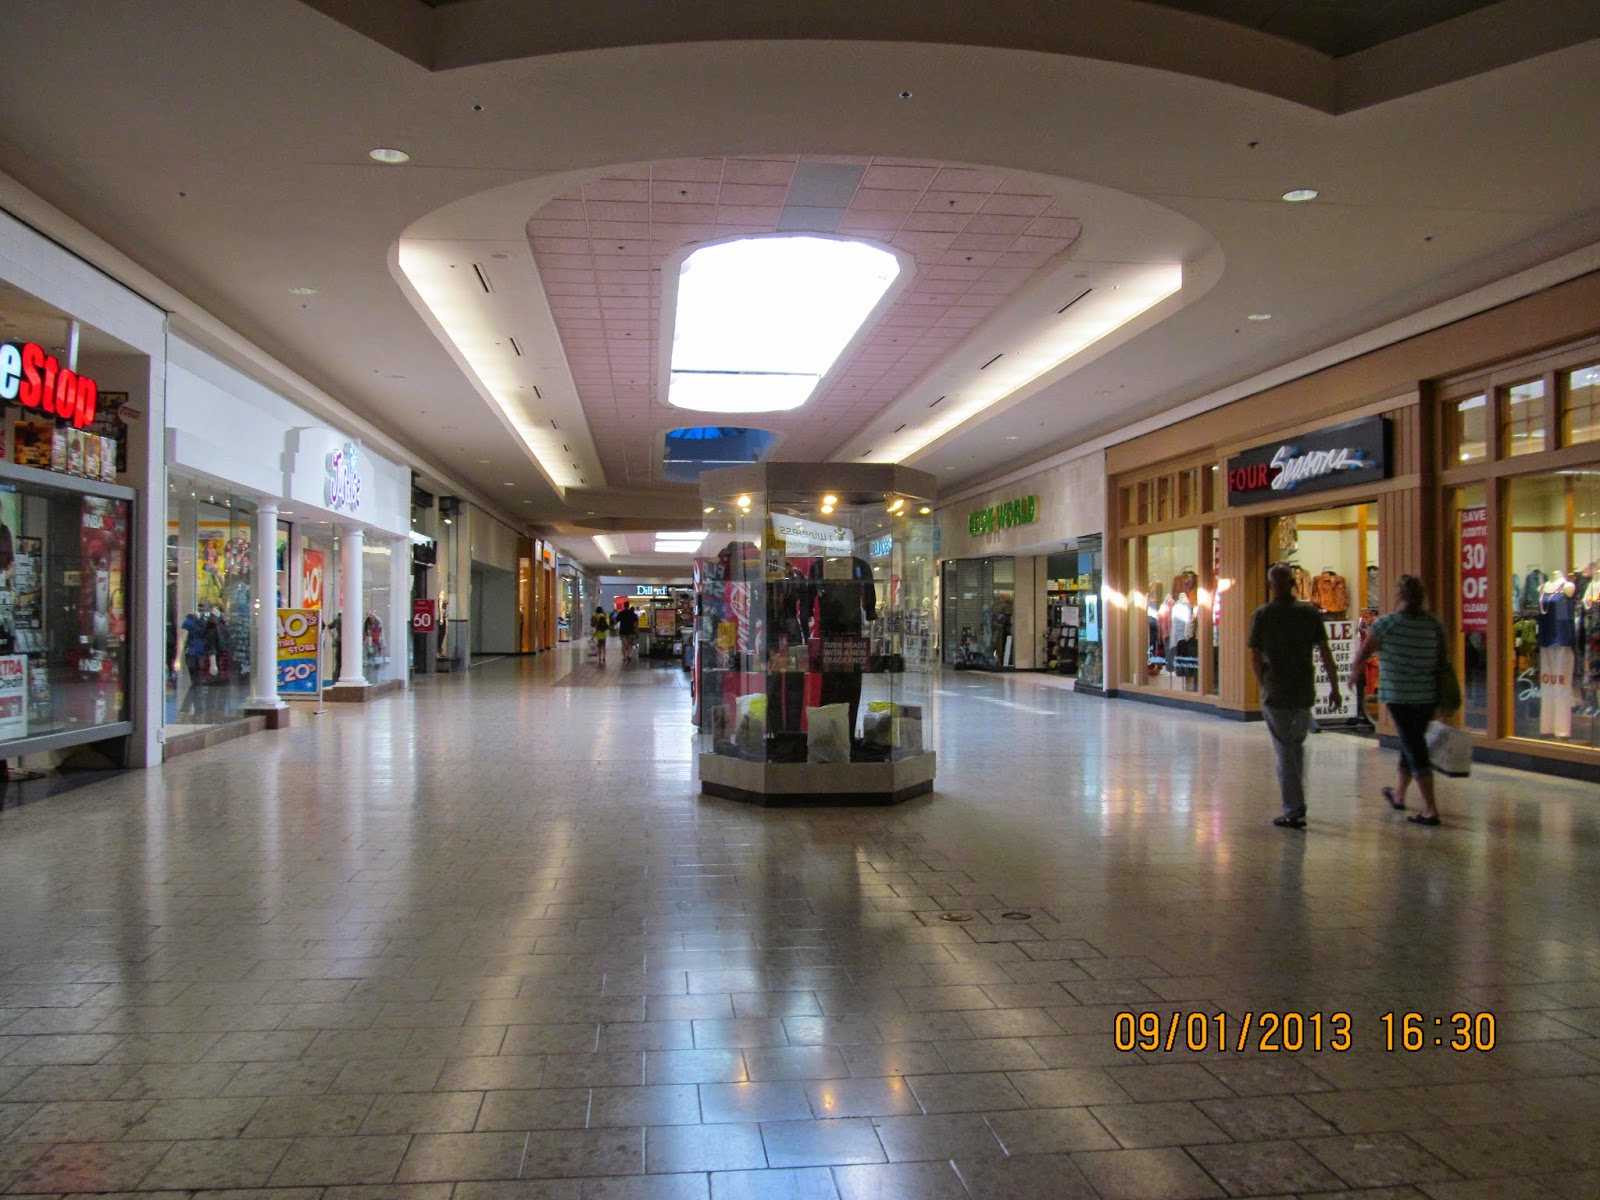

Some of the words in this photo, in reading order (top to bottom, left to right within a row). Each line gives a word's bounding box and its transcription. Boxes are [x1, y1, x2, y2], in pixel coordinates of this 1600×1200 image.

[1229, 463, 1268, 493] FOUR
[1270, 445, 1363, 490] Seasons
[329, 443, 362, 509] Justice
[997, 496, 1035, 529] WORLD
[1462, 510, 1487, 522] SAVE
[1462, 543, 1488, 570] 30
[636, 585, 668, 595] Dillrd
[413, 613, 431, 627] 60
[1329, 623, 1353, 641] LE
[277, 639, 295, 648] TIRE
[823, 641, 843, 649] TURN
[843, 641, 867, 649] HEADS
[1331, 643, 1350, 652] SALE
[288, 644, 317, 655] STORE
[823, 656, 867, 664] FRAGRANCE
[1335, 653, 1350, 662] OFF
